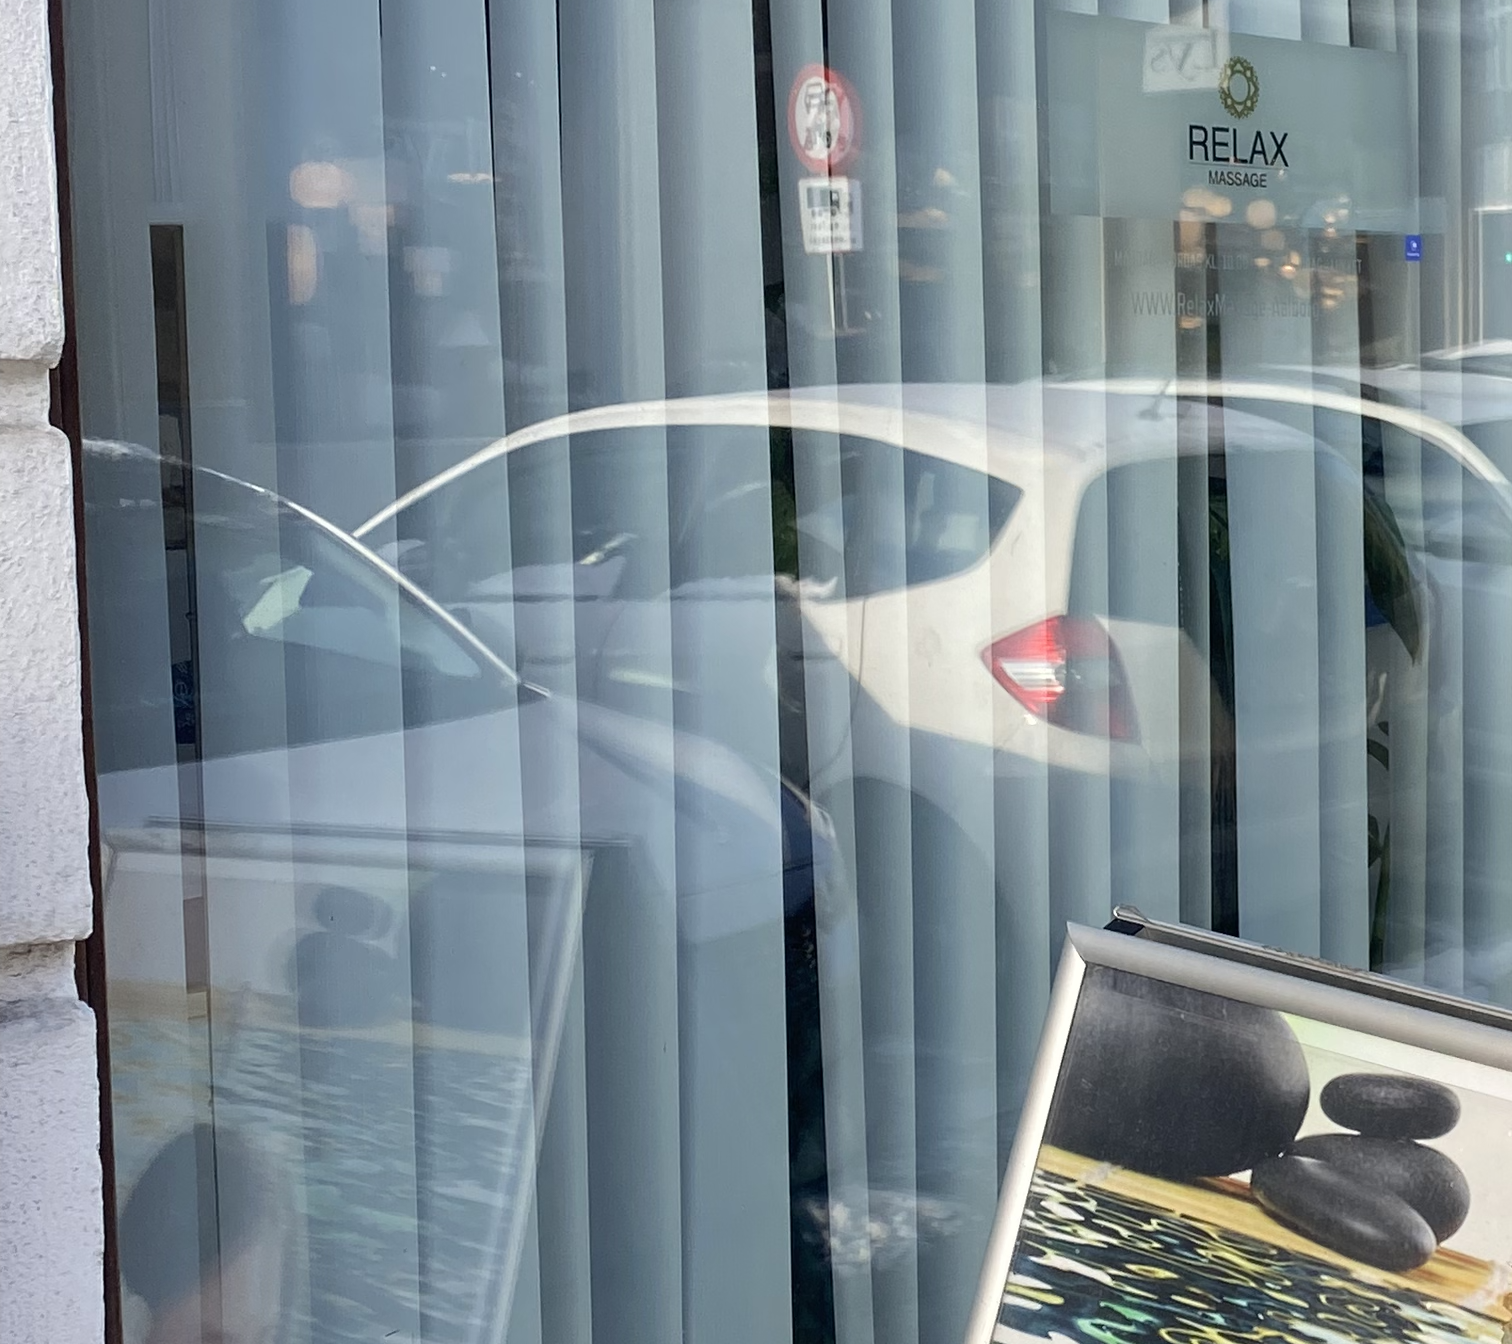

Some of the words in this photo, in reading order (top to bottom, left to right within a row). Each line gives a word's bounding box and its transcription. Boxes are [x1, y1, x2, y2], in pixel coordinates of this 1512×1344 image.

[1188, 124, 1289, 168] RELAX
[1208, 170, 1268, 188] MASSAGE
[1130, 290, 1319, 321] WWW.RelaxMage-Aalborg
